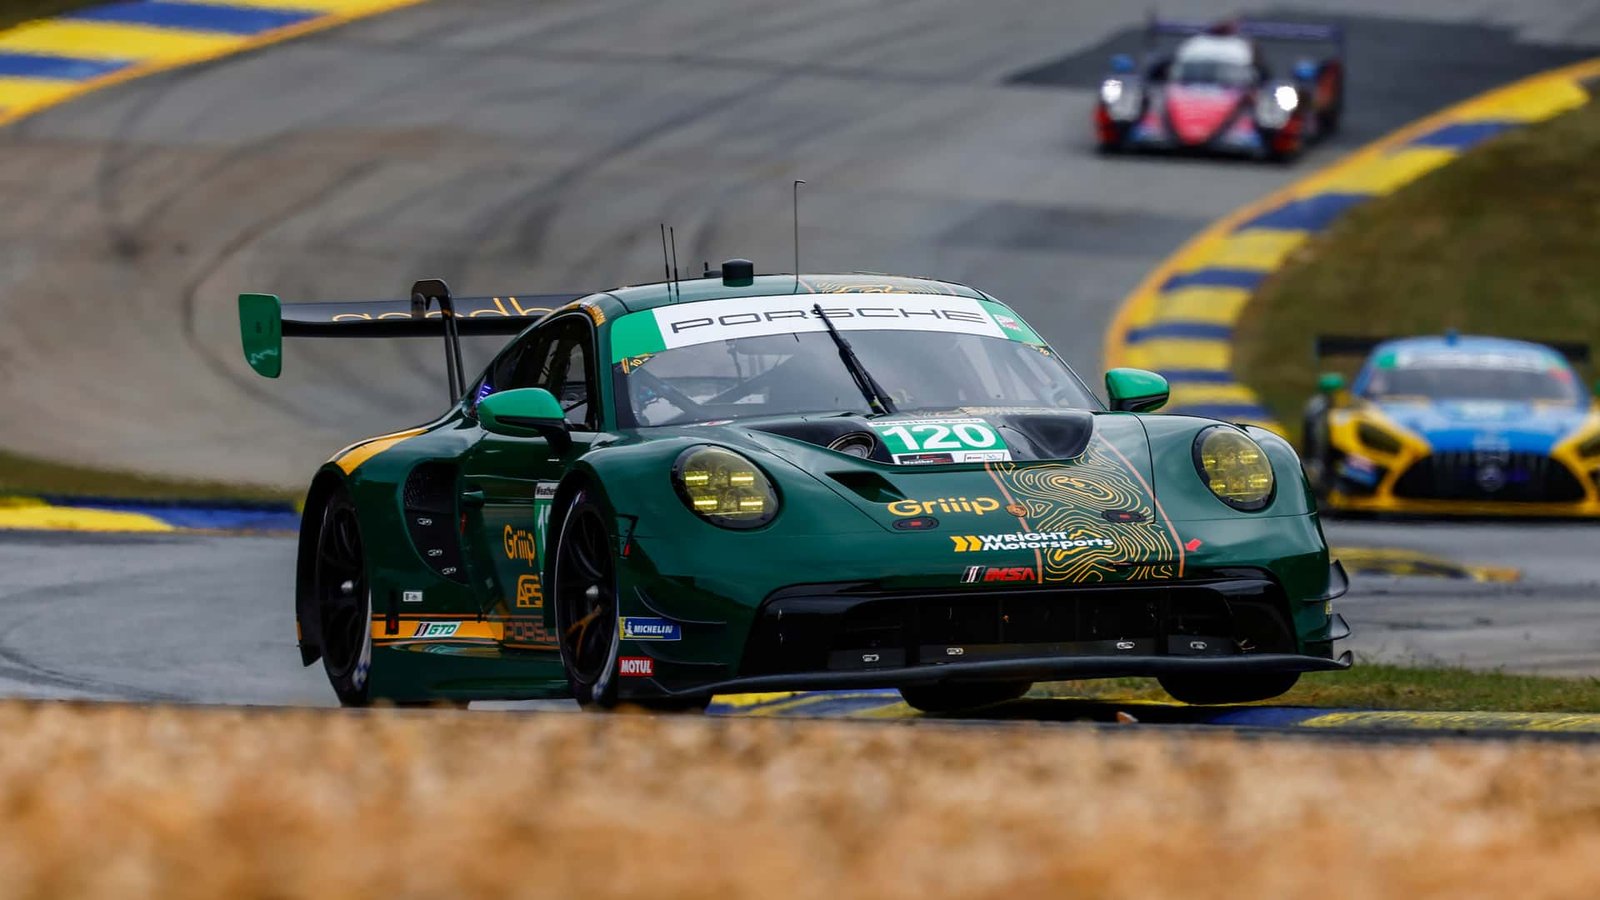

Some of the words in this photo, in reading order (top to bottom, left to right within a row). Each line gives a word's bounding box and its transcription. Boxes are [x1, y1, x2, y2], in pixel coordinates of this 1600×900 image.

[670, 307, 987, 334] PORSCHE
[882, 424, 996, 450] 120
[887, 497, 1000, 516] Griiip
[503, 525, 535, 567] Griiip
[982, 539, 1114, 550] Motorsports
[983, 566, 1036, 582] IMSA
[427, 624, 457, 635] GTD
[633, 625, 674, 634] MICHELIN
[621, 660, 652, 674] MOTUL
